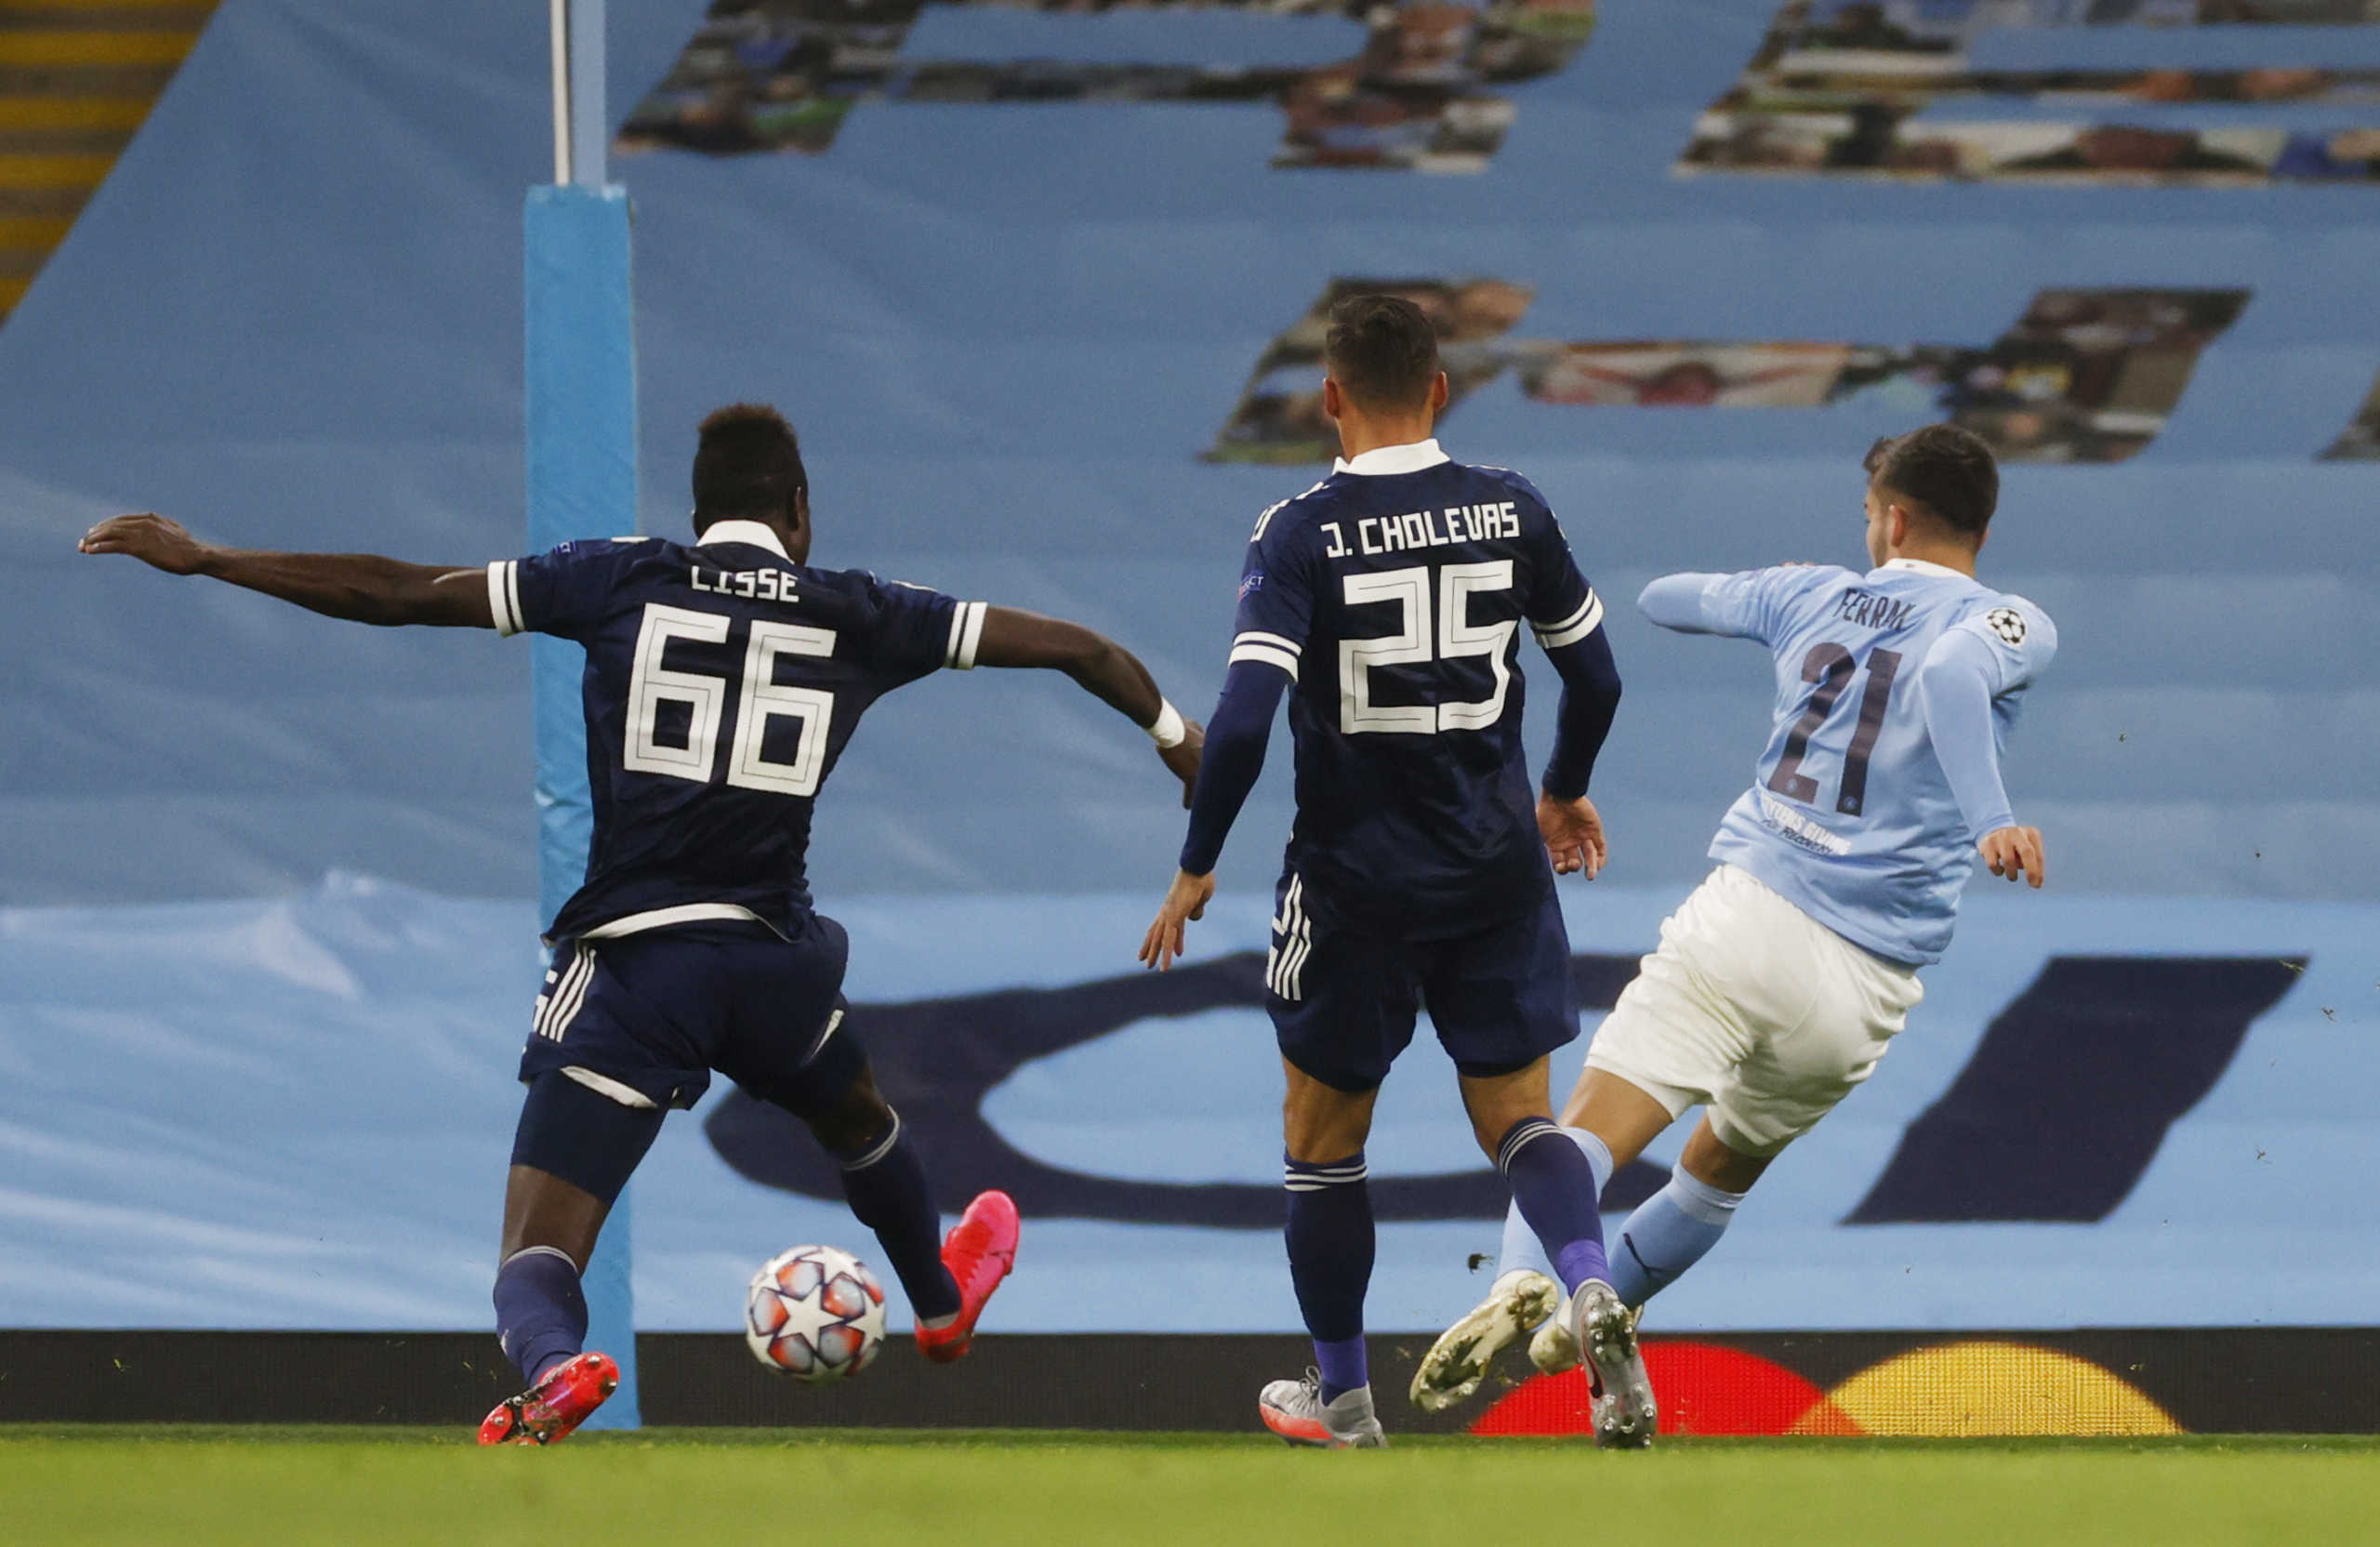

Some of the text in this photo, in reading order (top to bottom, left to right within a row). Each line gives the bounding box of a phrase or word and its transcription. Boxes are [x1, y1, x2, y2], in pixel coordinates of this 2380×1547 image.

[1320, 501, 1520, 558] J. CHOLEVAS
[623, 602, 838, 797] 66
[1338, 560, 1518, 734] 25
[1767, 641, 1903, 817] 21
